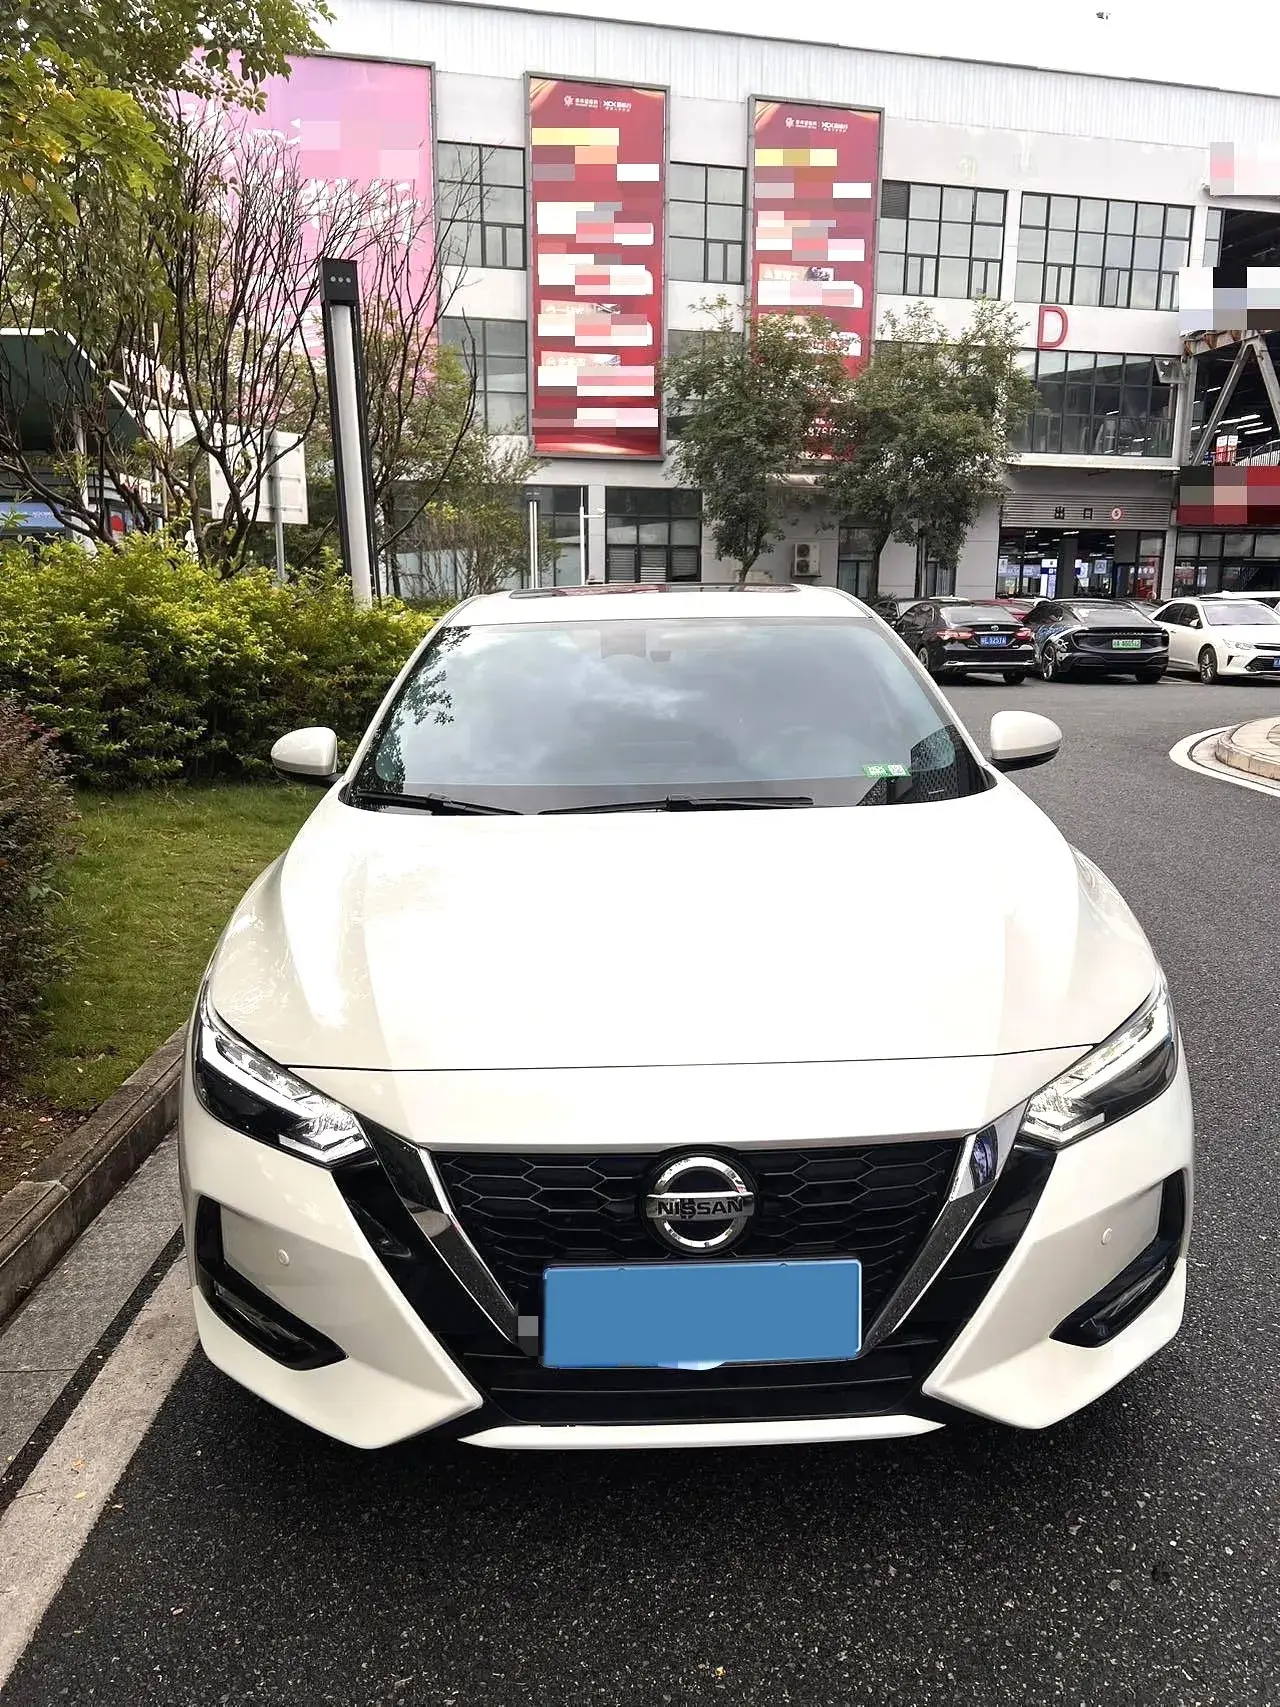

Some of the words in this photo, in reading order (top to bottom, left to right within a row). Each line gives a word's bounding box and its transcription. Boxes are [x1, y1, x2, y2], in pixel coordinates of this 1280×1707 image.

[1037, 305, 1068, 350] D
[1054, 506, 1093, 520] 出口
[657, 1199, 743, 1216] NISSAN
